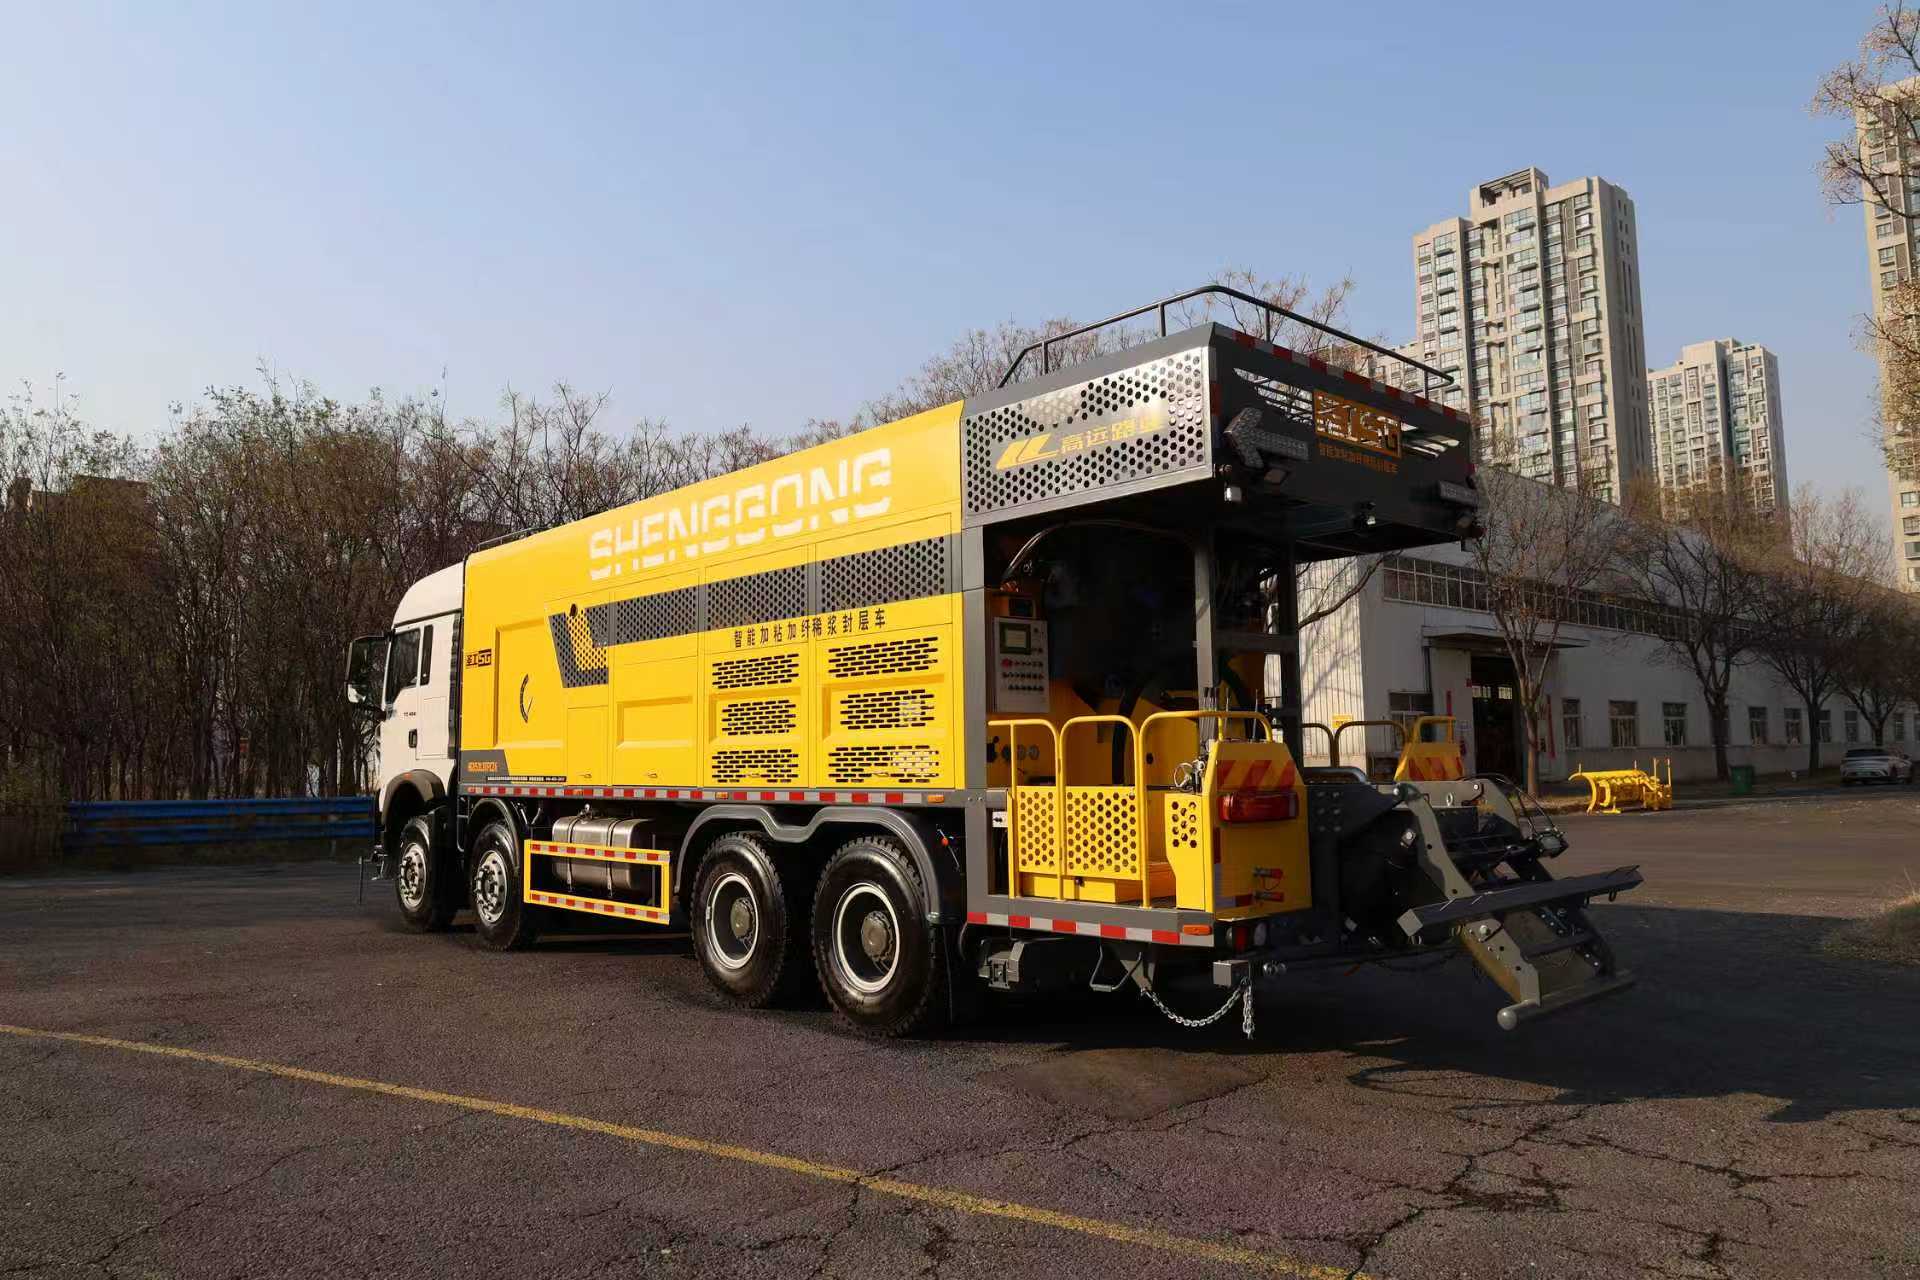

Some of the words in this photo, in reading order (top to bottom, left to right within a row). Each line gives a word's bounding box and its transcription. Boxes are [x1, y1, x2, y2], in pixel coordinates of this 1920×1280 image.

[588, 447, 892, 580] SHENGGONG
[734, 608, 886, 648] 智能加粘加纤稀浆封层车
